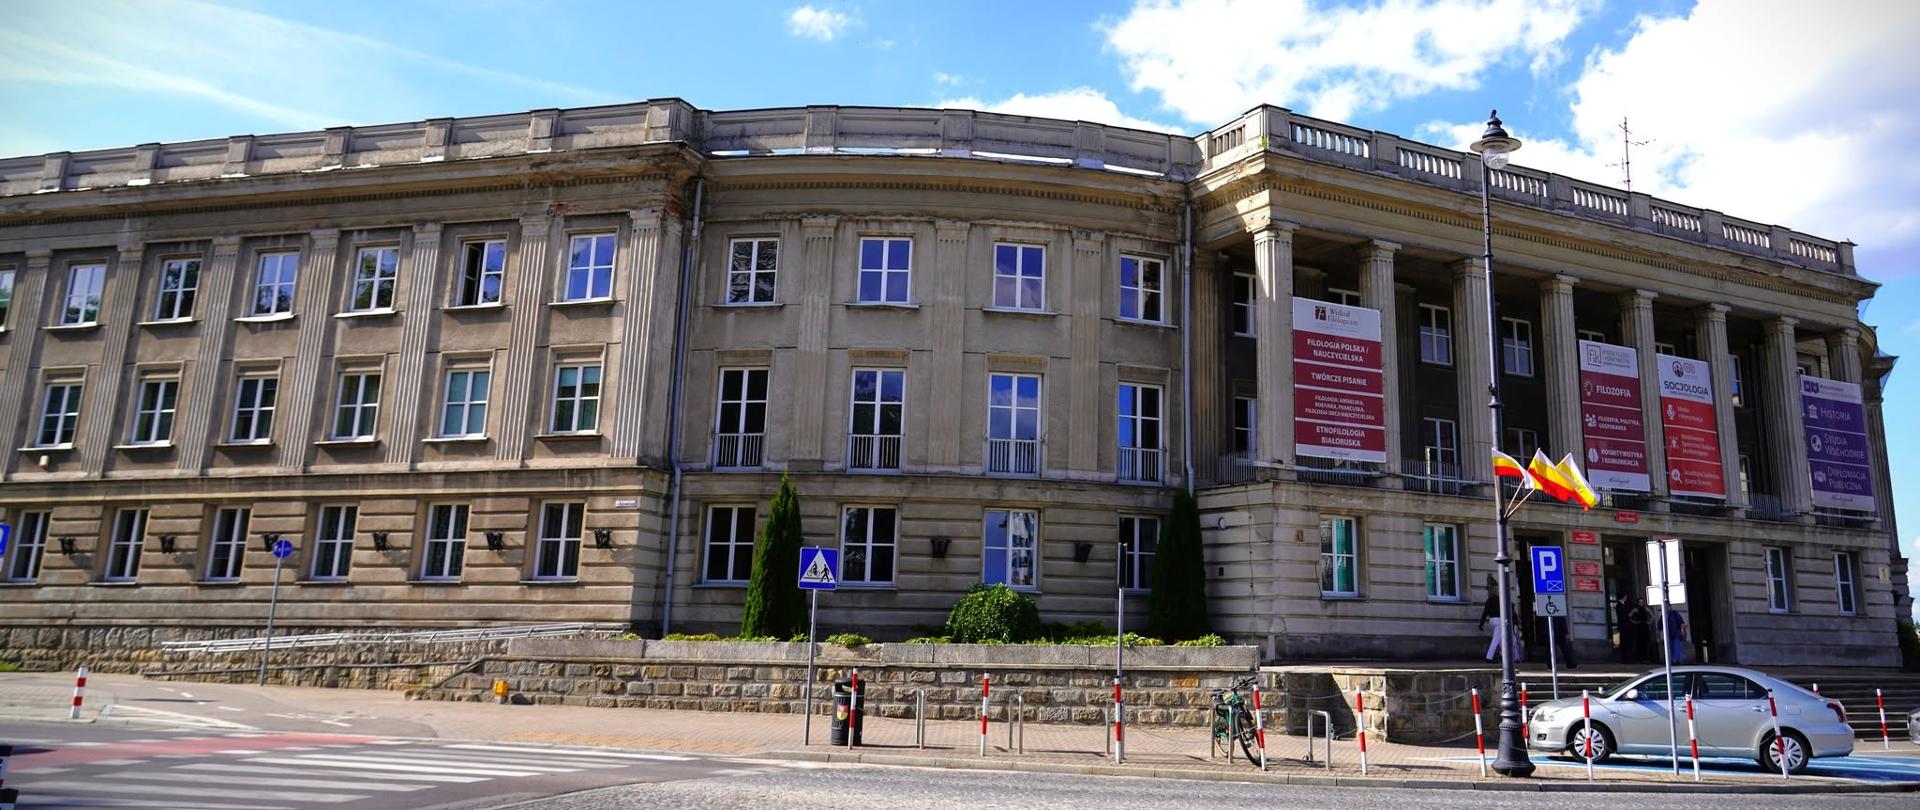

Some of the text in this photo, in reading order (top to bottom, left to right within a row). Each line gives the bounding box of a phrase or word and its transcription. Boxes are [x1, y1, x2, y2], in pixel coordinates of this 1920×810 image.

[1307, 338, 1340, 350] FILOLOGIA
[1341, 343, 1365, 353] POLSKA
[1313, 349, 1364, 362] NAUCZYCIELSKA
[1311, 372, 1367, 386] TWÓRCZE PISANIE
[1596, 385, 1631, 398] FILOZOFIA
[1663, 380, 1709, 396] SOCJOLOGIA
[1820, 407, 1851, 421] HISTORIA
[1316, 425, 1366, 438] ETNOFILOLOGIA
[1824, 432, 1848, 445] STUDIA
[1321, 436, 1361, 447] BIAŁORUSKA
[1825, 445, 1865, 459] WSCHODNIE
[1539, 551, 1557, 580] P
